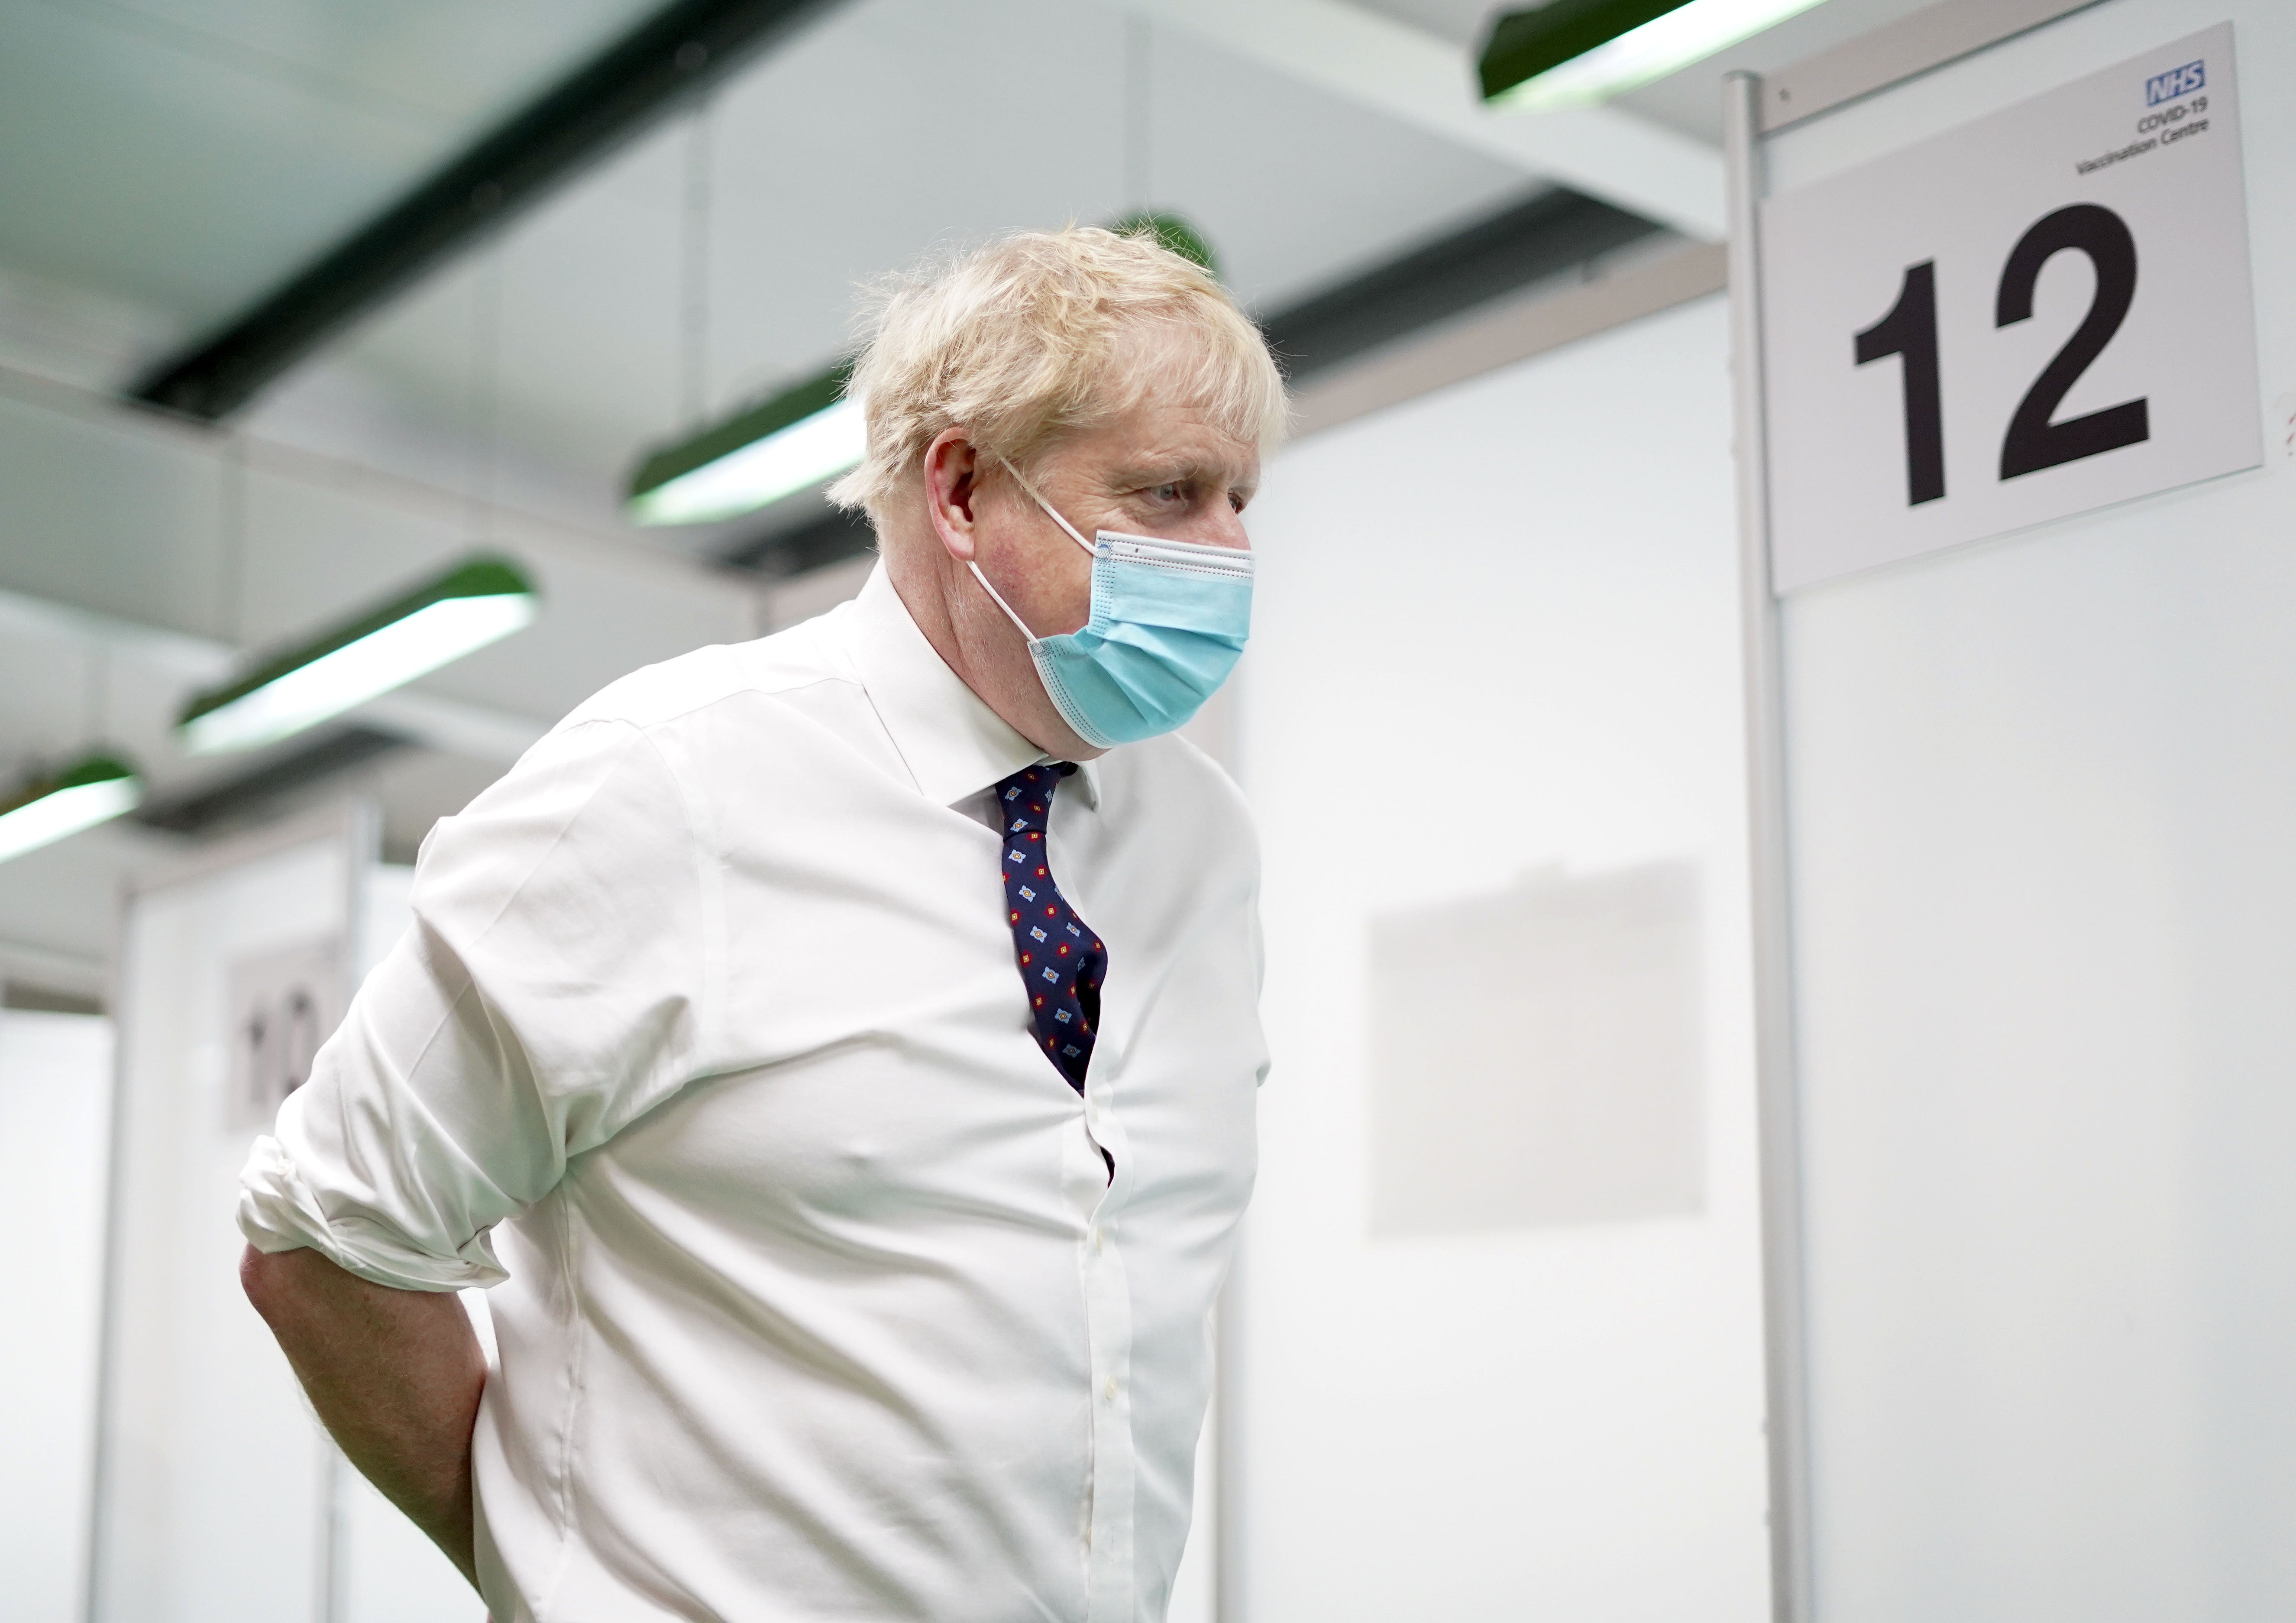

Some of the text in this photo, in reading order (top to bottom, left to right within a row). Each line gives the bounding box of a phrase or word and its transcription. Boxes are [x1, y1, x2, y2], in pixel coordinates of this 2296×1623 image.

[2147, 62, 2204, 105] NHS
[2137, 96, 2209, 134] COVID-19
[2076, 118, 2210, 175] Vaccination Centre
[1854, 203, 2149, 506] 12
